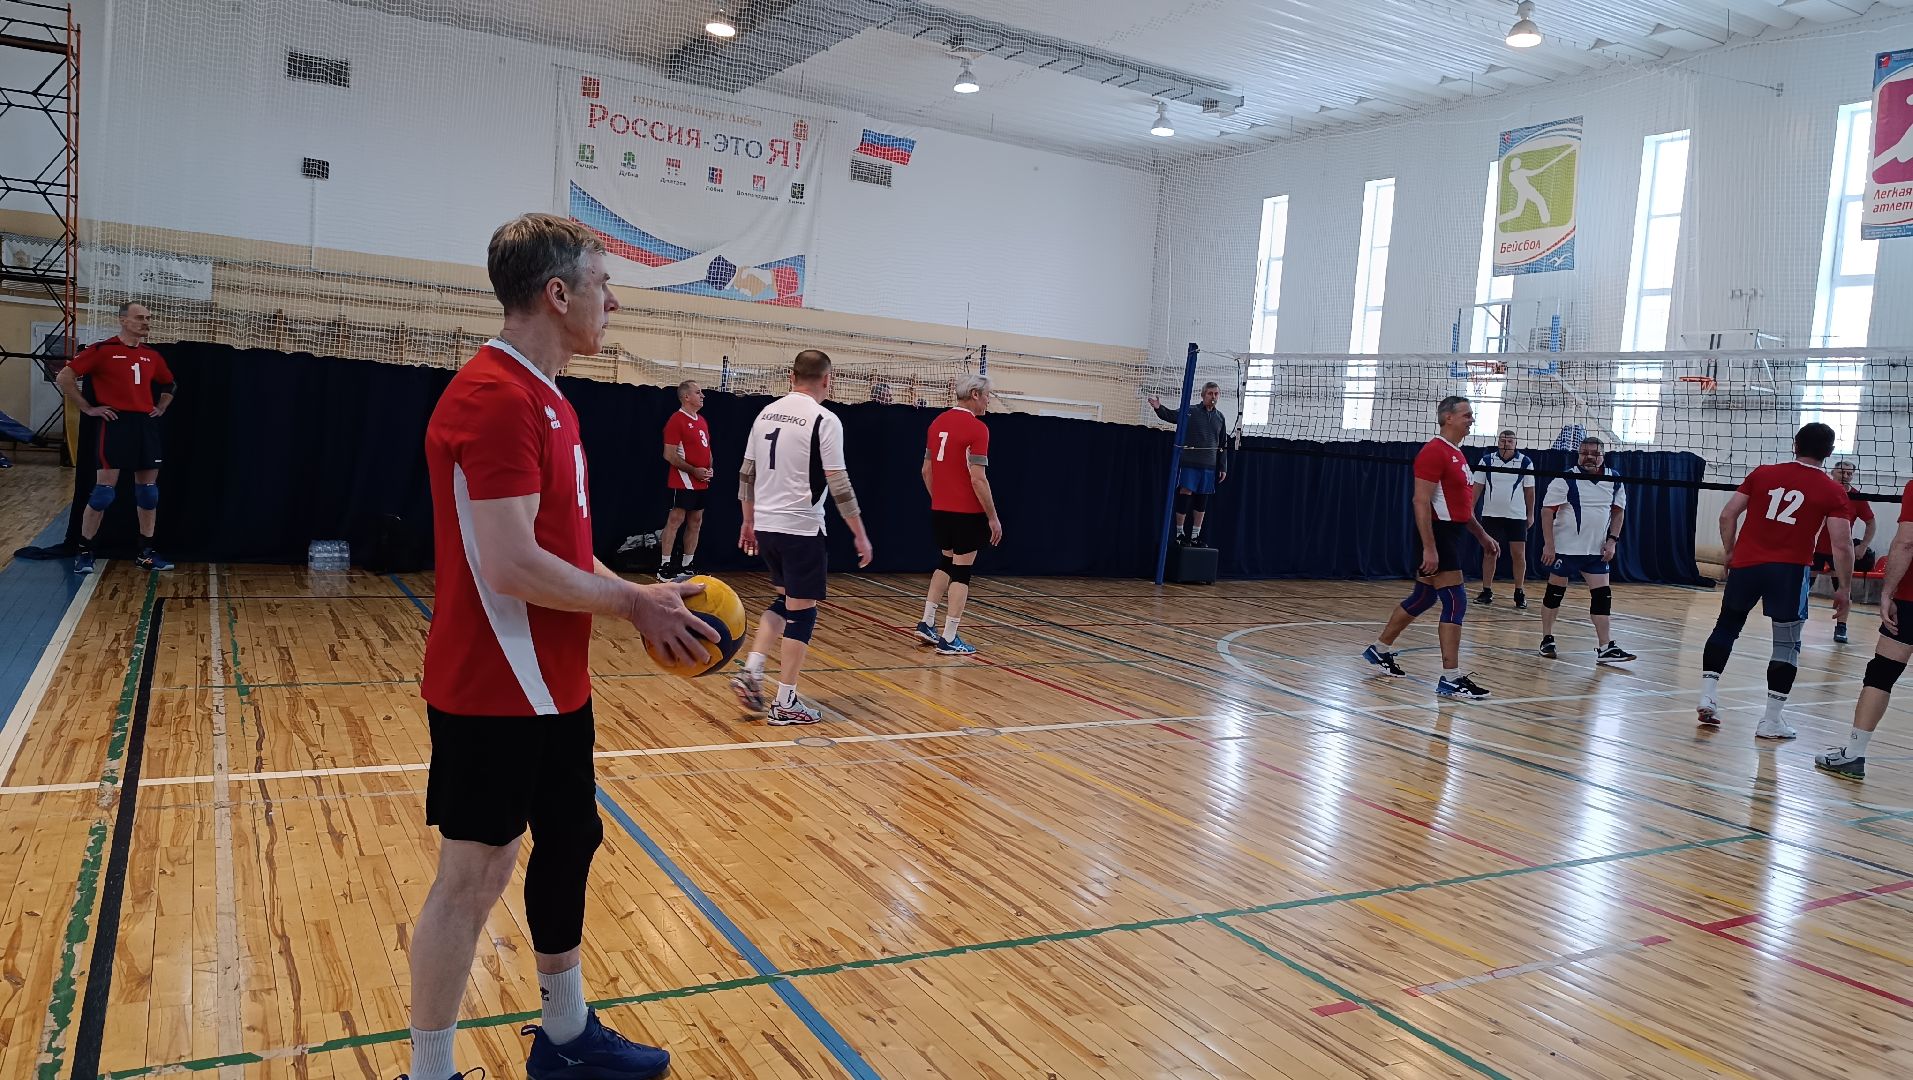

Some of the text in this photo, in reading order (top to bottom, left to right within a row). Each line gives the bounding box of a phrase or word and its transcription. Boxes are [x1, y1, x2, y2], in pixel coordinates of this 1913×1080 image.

[1873, 186, 1913, 201] Легкая
[1499, 239, 1542, 254] Бейсбол
[131, 362, 141, 385] 1
[698, 429, 708, 448] 3
[764, 427, 781, 470] 1
[1765, 486, 1805, 525] 12
[1553, 558, 1563, 570] 6
